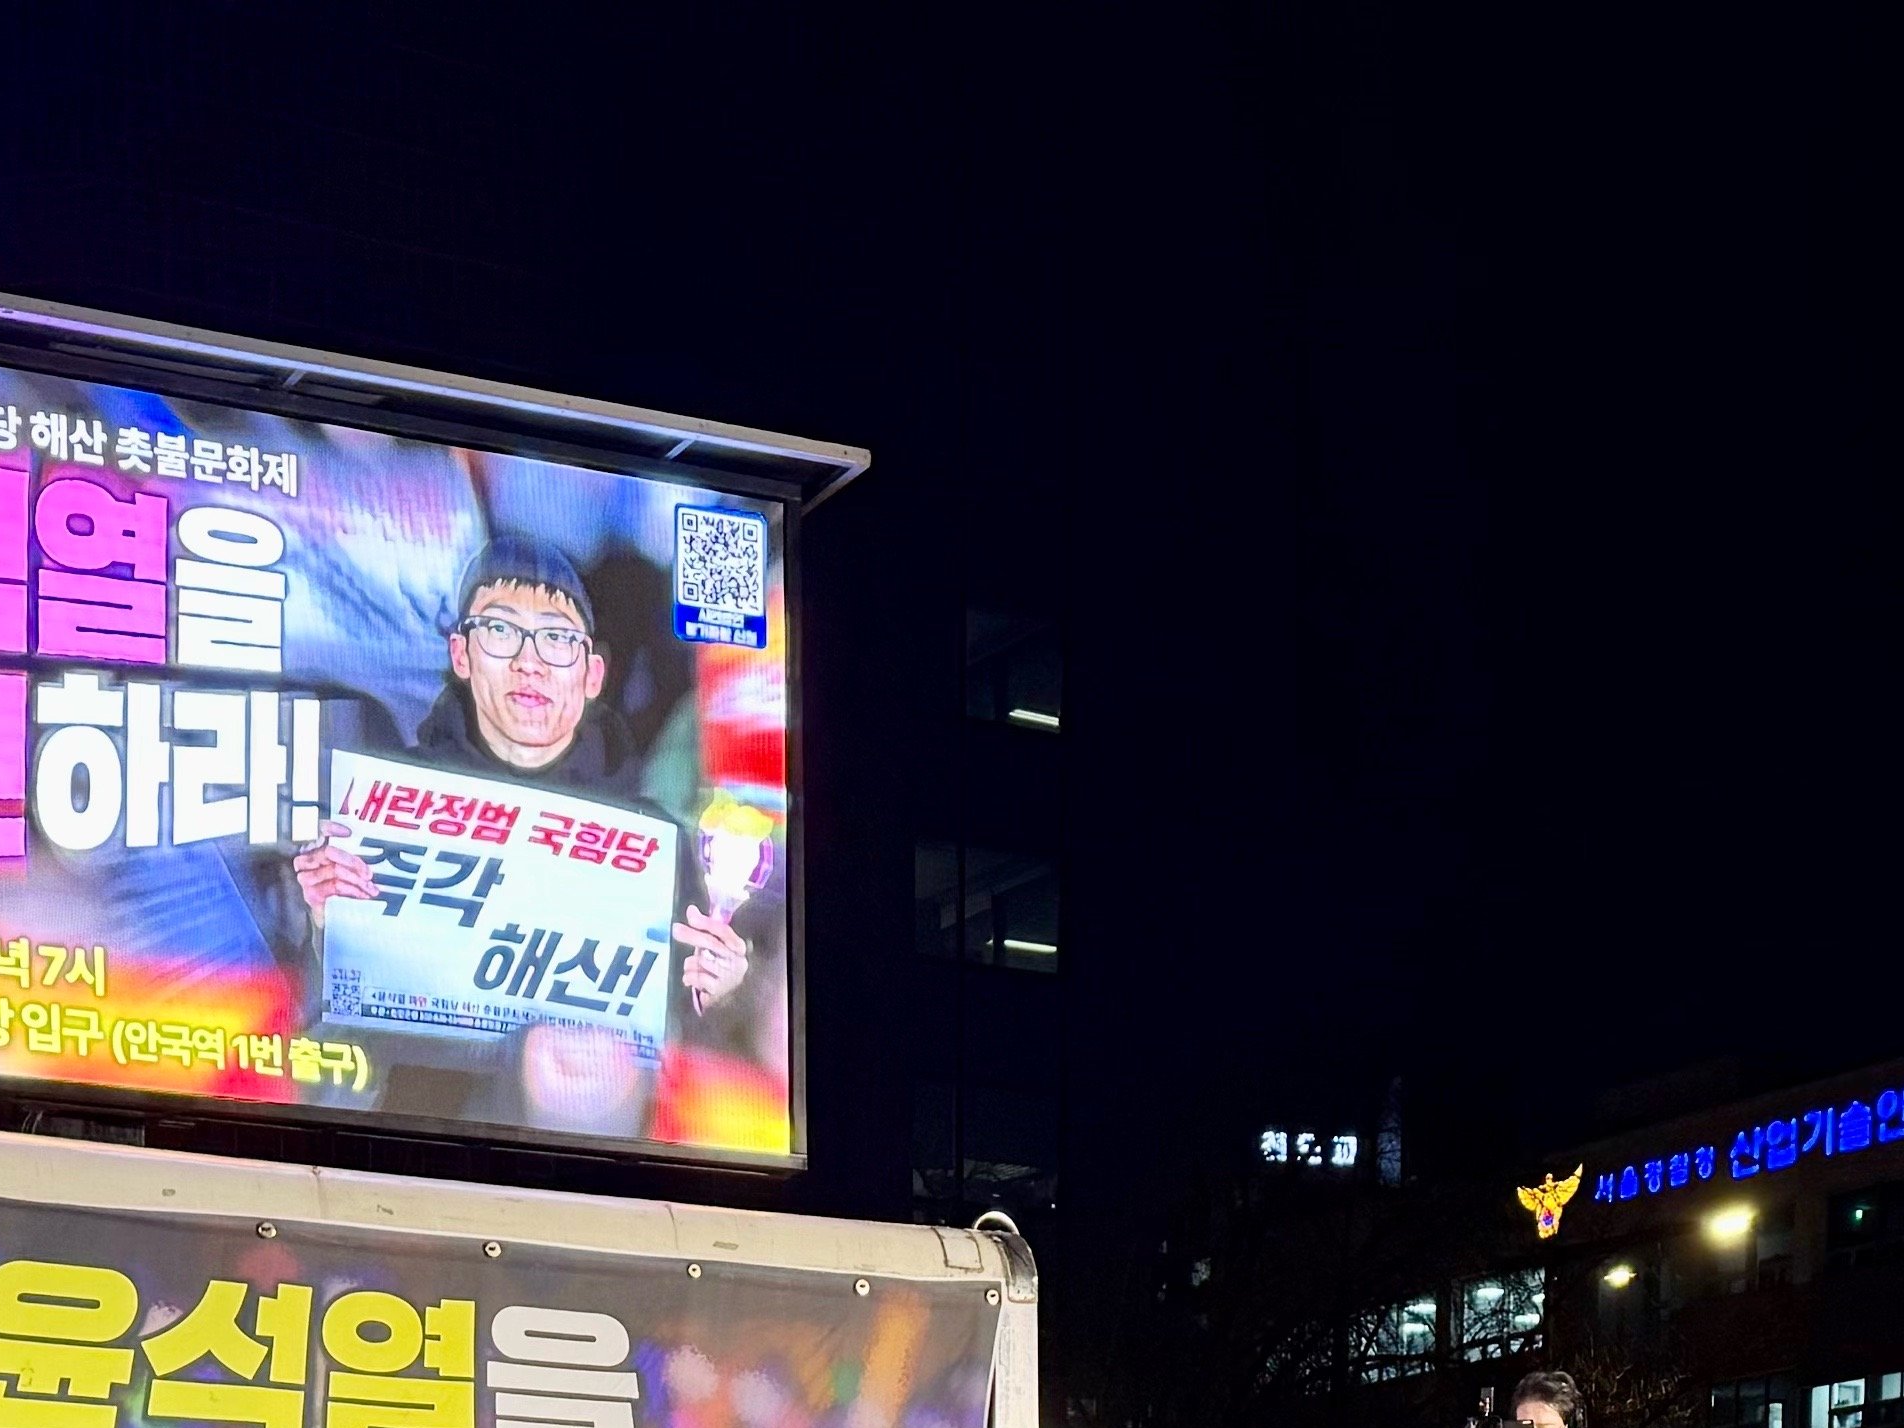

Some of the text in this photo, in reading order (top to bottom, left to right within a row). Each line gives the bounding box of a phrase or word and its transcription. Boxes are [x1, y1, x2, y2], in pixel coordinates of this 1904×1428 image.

[30, 411, 107, 467] 해산
[114, 426, 299, 498] 촛불문화제
[527, 810, 660, 874] 국힘당
[37, 945, 107, 997] 7시
[473, 922, 659, 1017] 해산!
[20, 1003, 104, 1057] 입구
[111, 1019, 227, 1072] (안국역
[230, 1032, 285, 1076] 1번
[288, 1036, 370, 1092] 출구)
